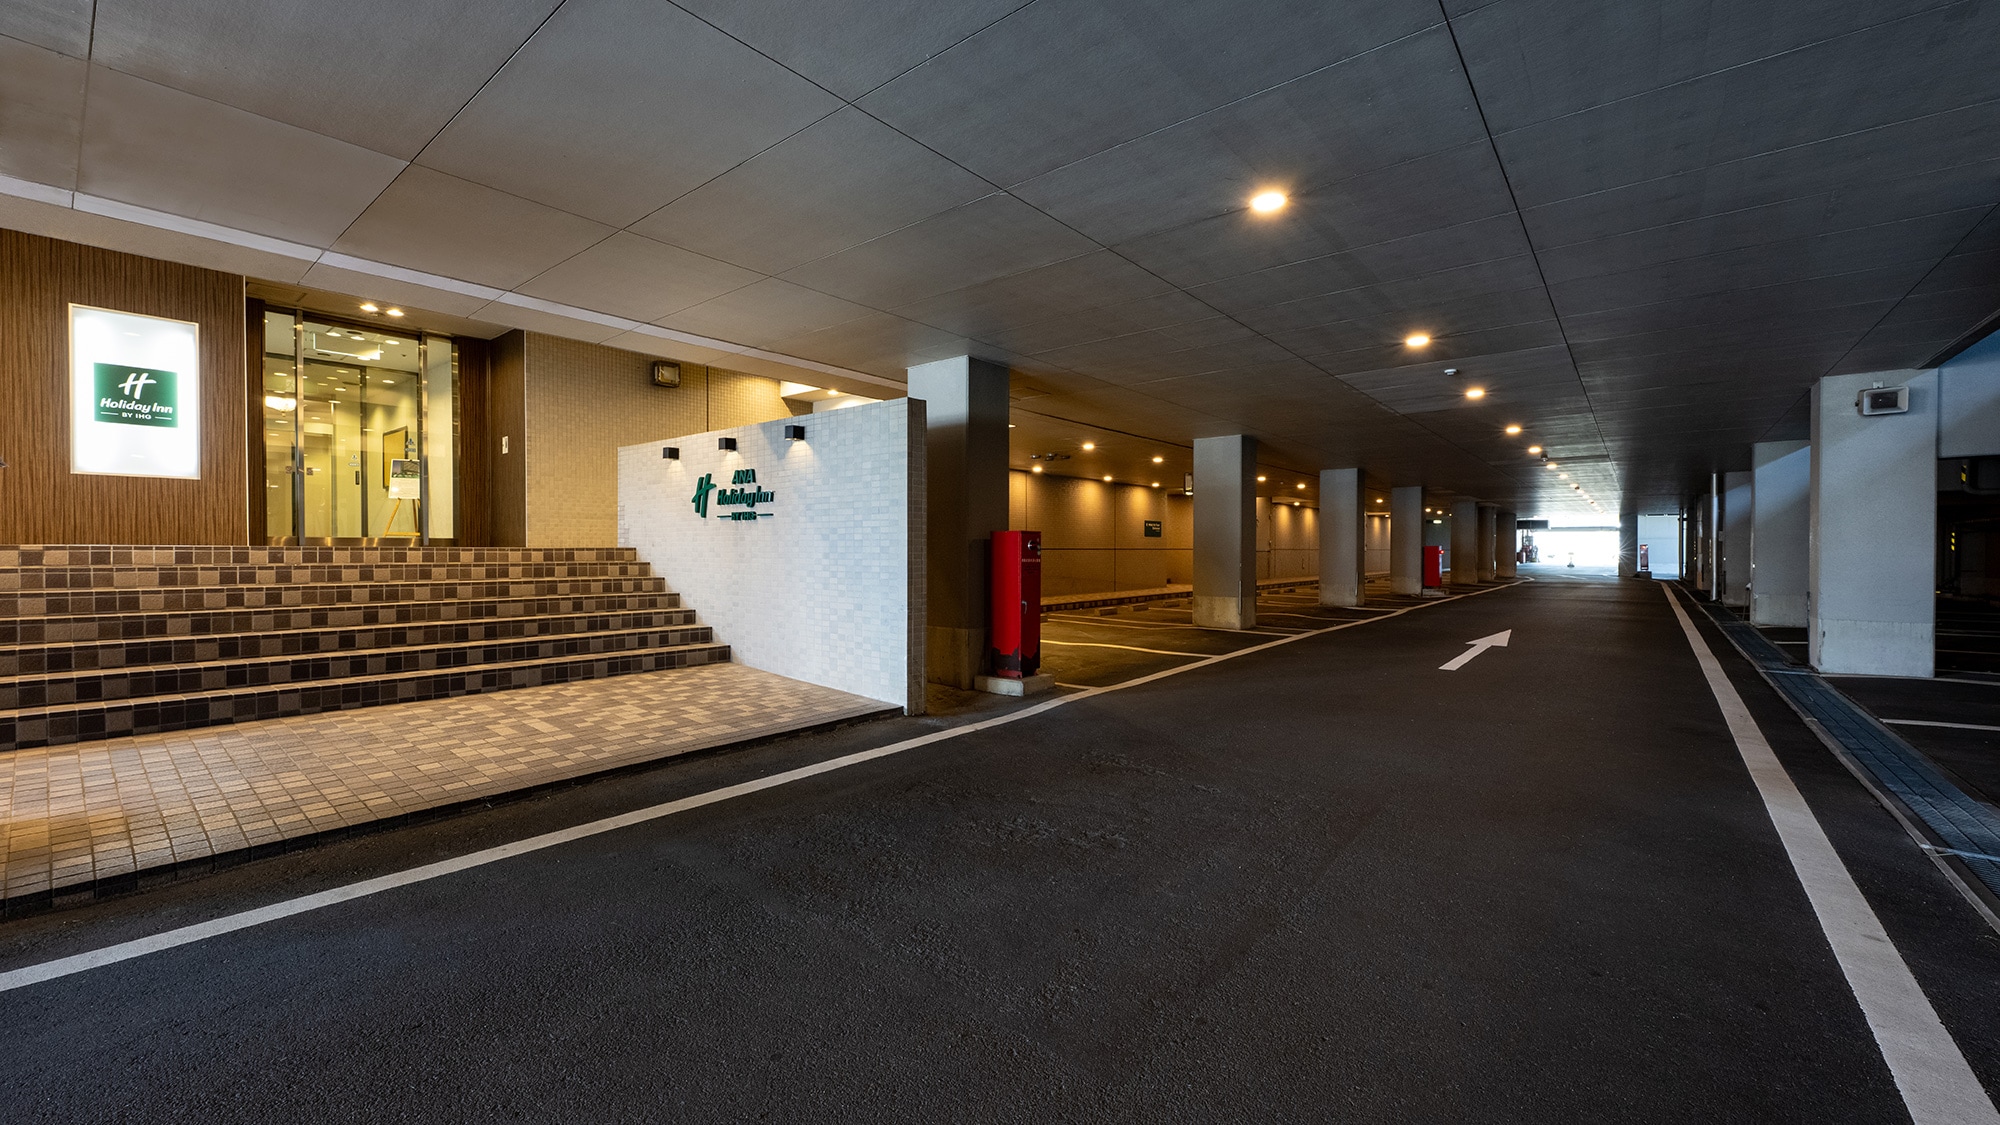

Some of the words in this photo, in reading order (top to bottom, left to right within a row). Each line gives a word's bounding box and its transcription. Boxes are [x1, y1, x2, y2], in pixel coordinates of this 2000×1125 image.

[100, 397, 151, 413] Holiday
[152, 402, 173, 413] Inn
[732, 468, 756, 484] ANA
[717, 488, 756, 508] Holiday
[755, 485, 775, 503] Inn
